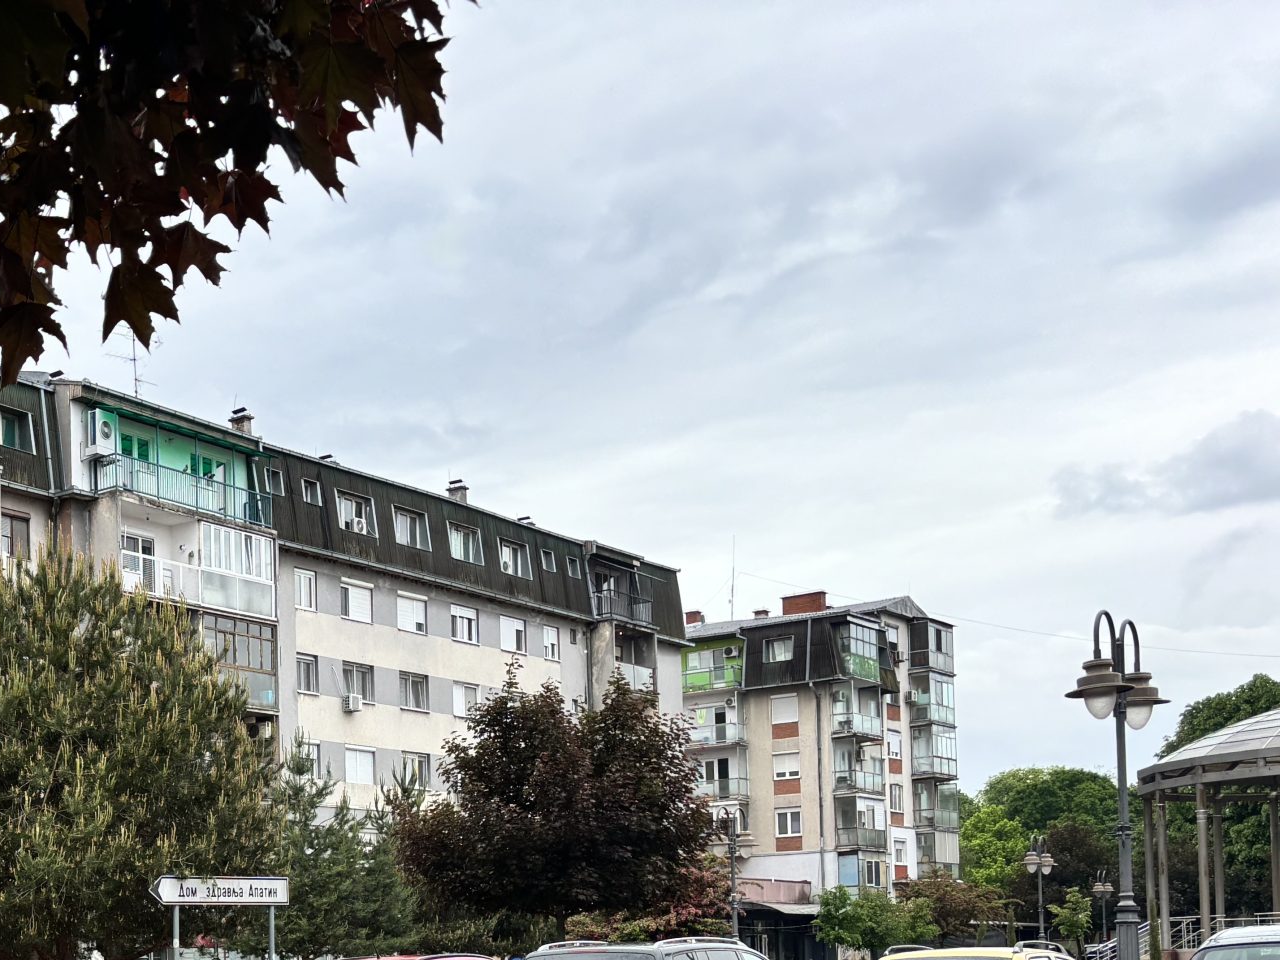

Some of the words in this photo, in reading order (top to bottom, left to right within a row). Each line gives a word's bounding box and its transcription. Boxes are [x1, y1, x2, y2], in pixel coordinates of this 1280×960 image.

[178, 883, 197, 898] Дом
[206, 884, 244, 900] здравља
[248, 883, 278, 898] Апатин
